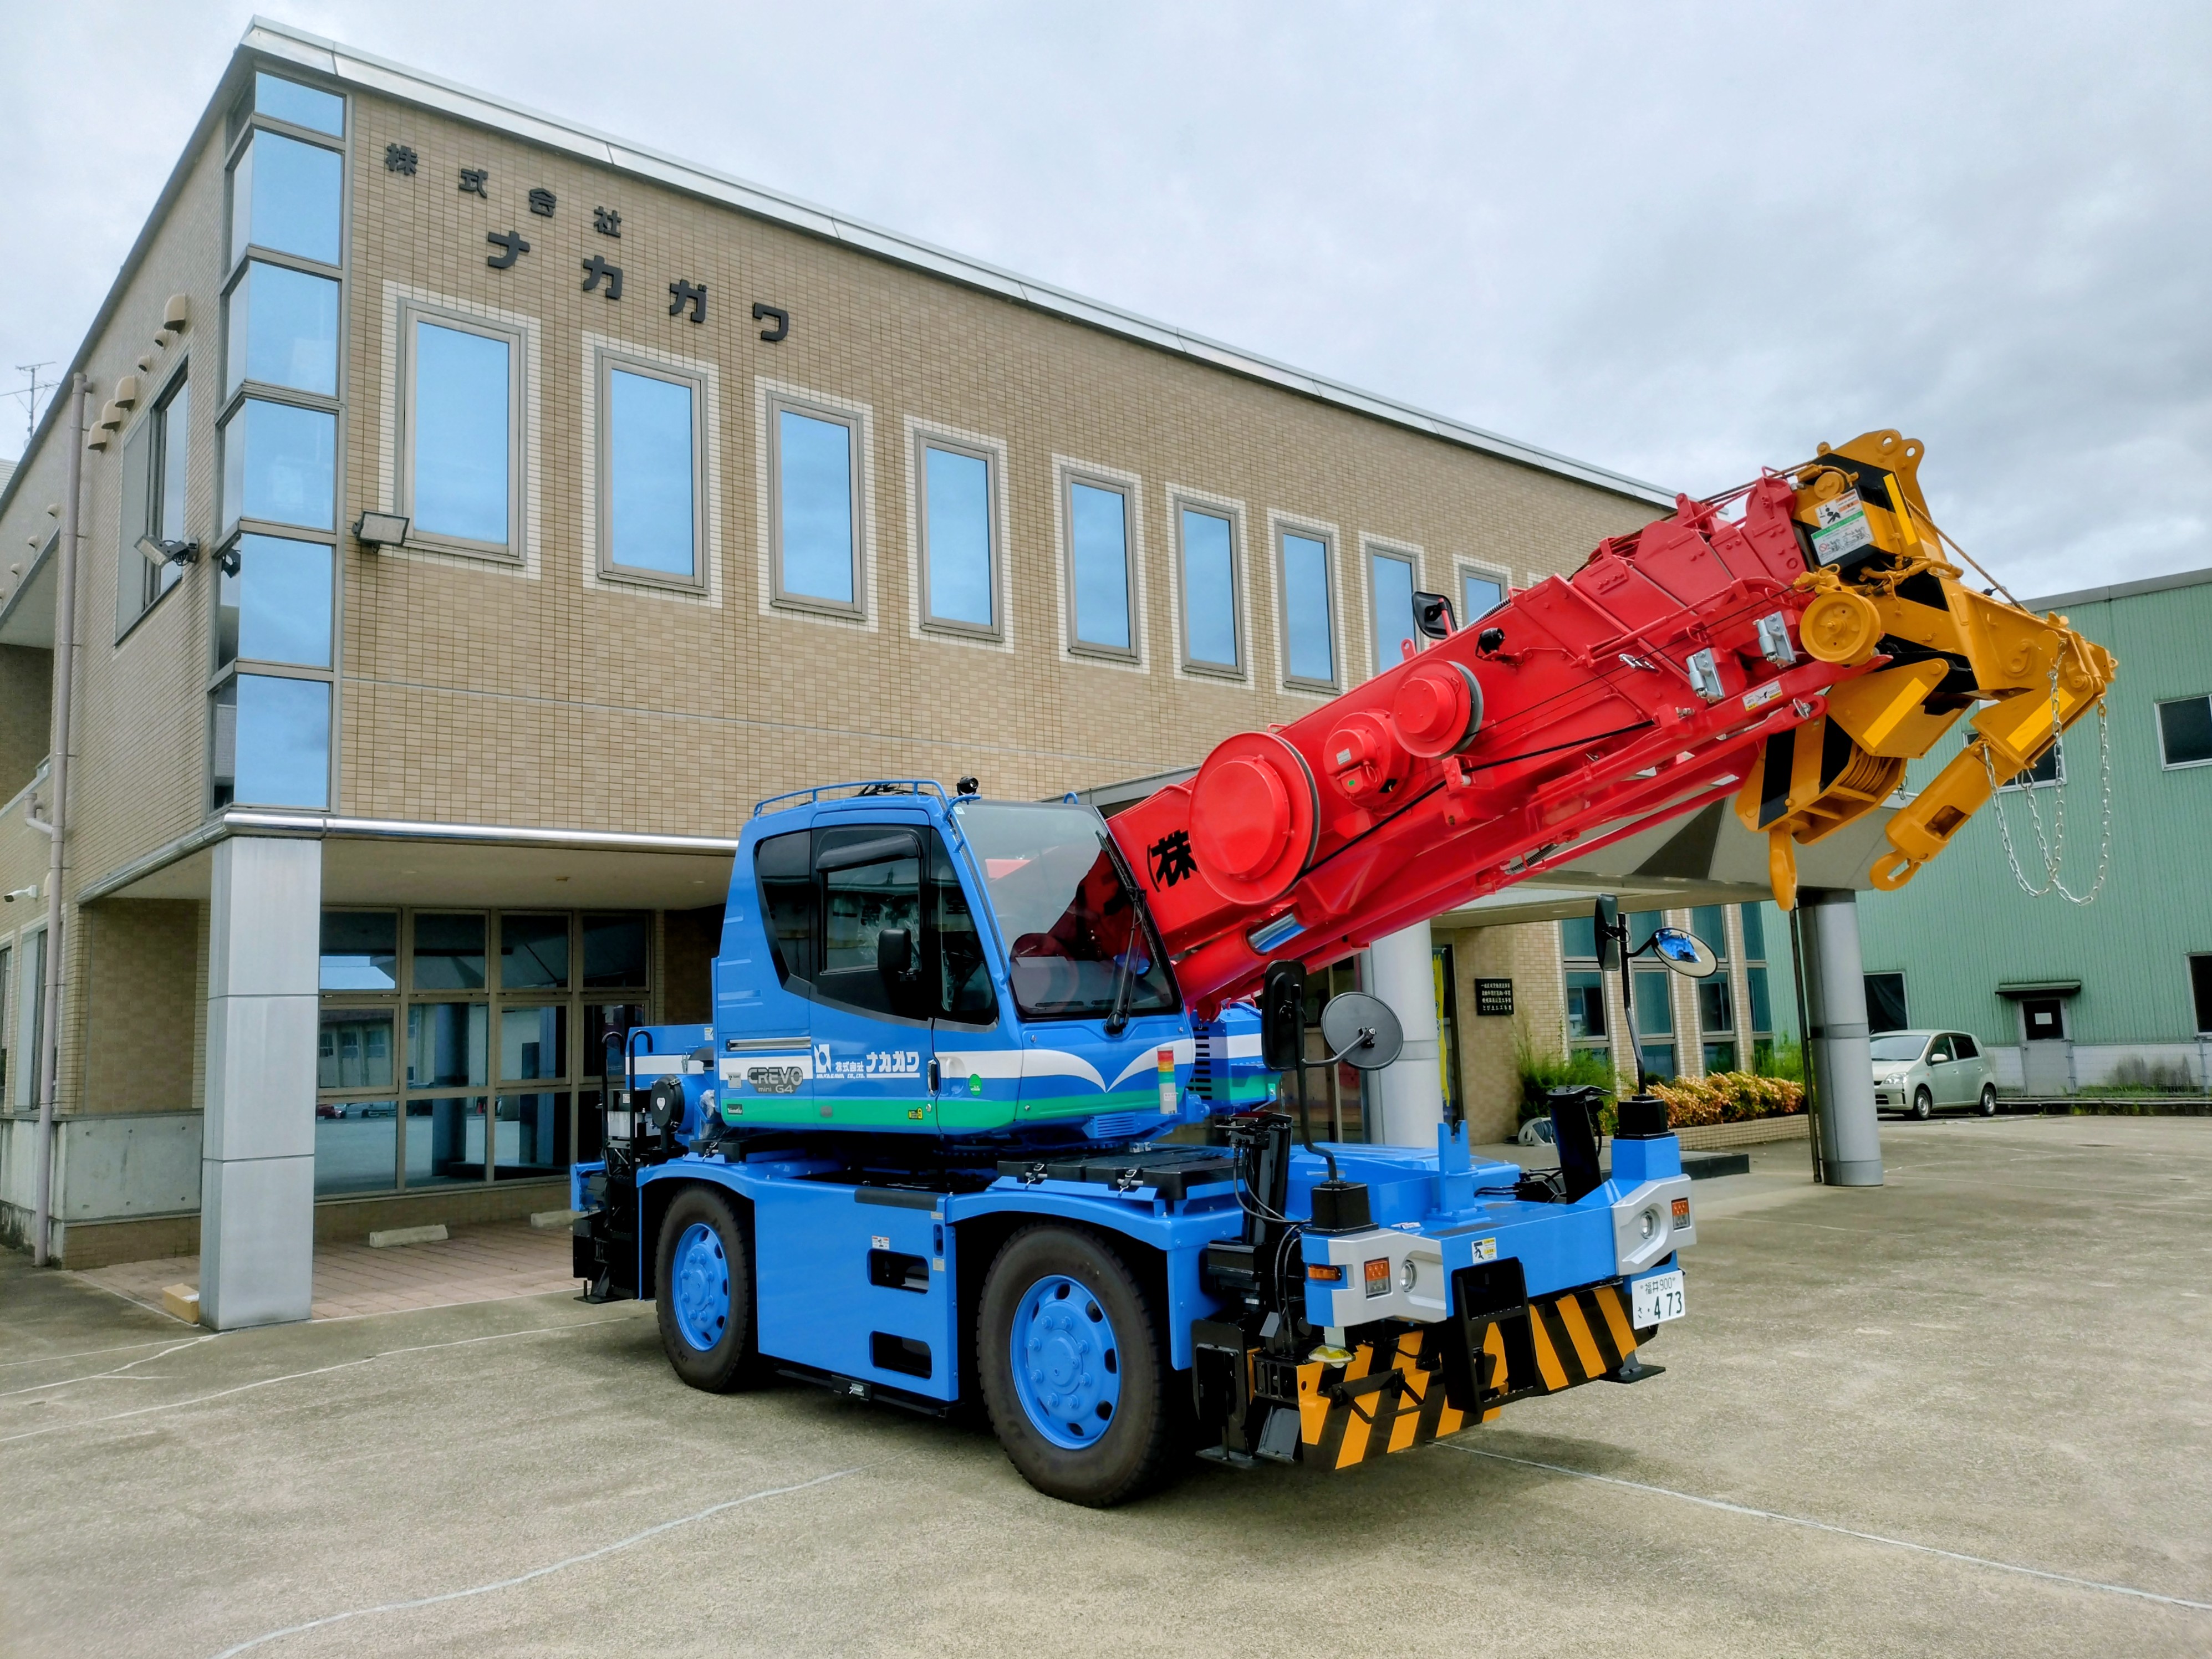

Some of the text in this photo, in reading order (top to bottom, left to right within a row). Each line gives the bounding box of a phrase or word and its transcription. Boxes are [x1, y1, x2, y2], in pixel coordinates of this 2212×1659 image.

[385, 142, 622, 238] 株式会社
[488, 231, 789, 342] ナカガワ
[835, 1051, 920, 1073] 株式会社 ナカガワ
[748, 1067, 803, 1086] CREVO
[776, 1084, 794, 1093] G4
